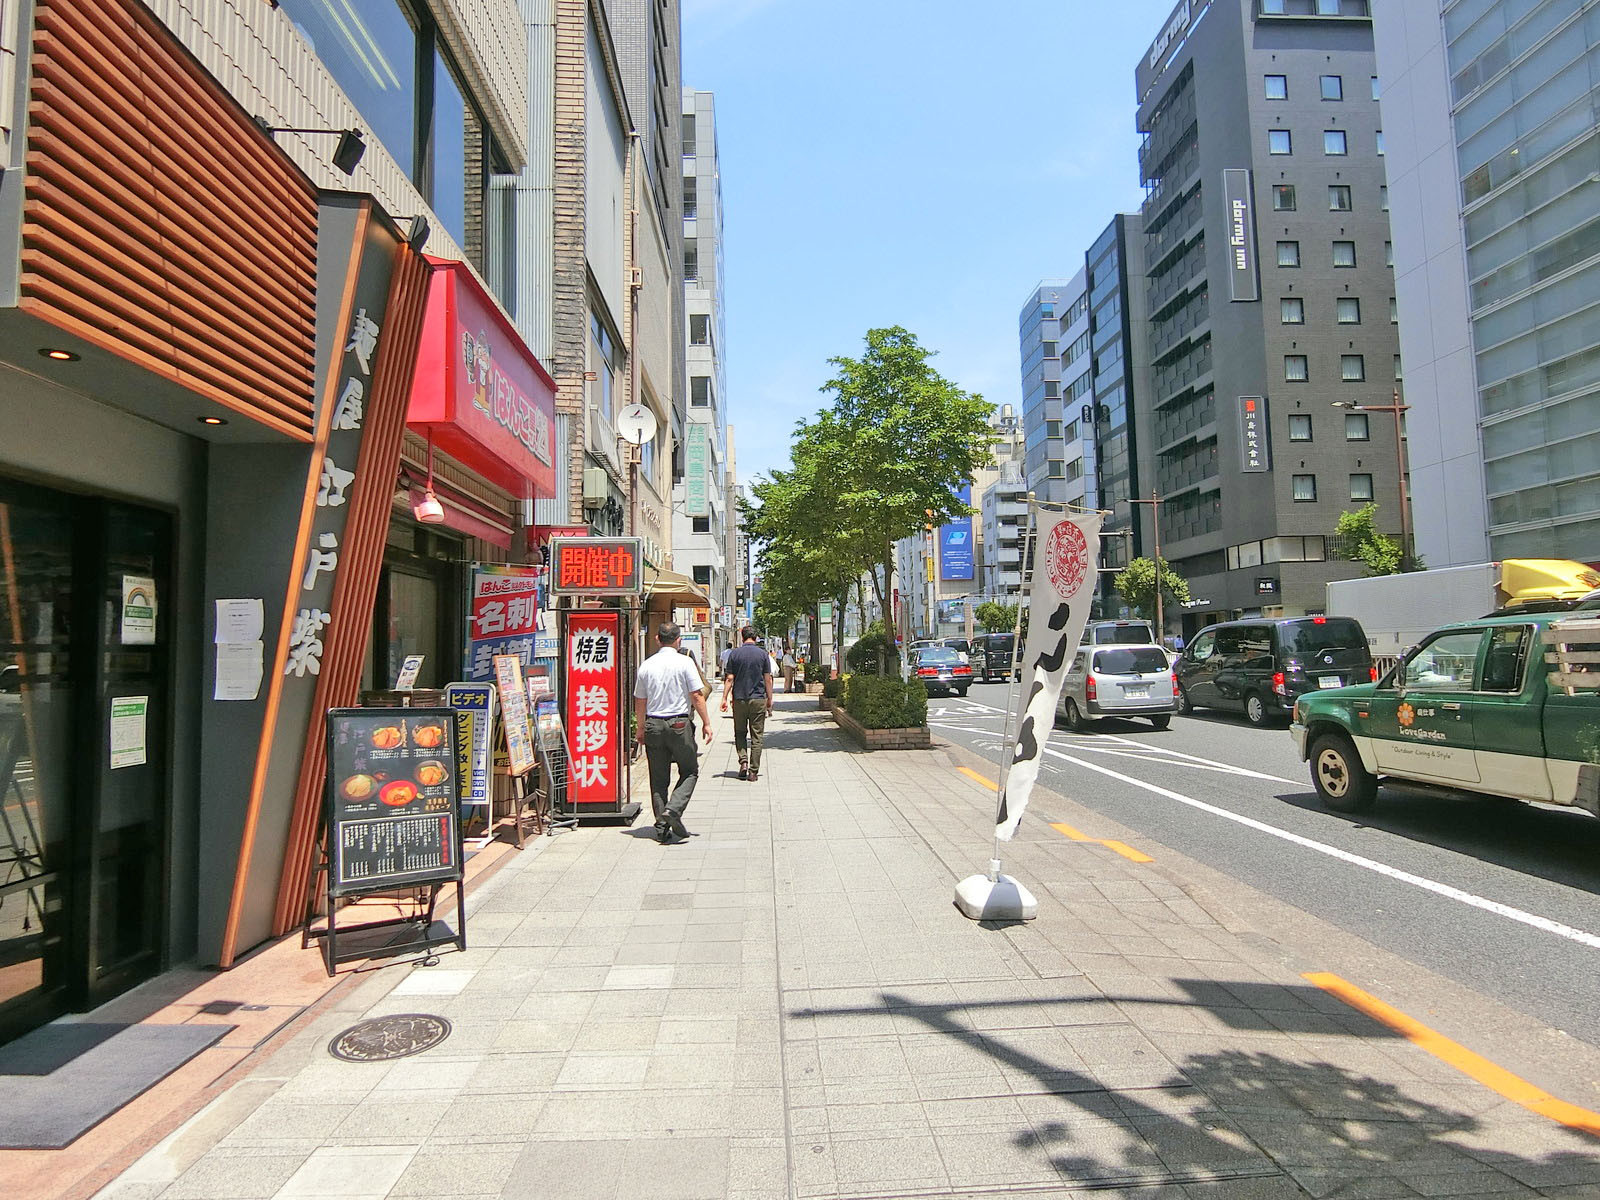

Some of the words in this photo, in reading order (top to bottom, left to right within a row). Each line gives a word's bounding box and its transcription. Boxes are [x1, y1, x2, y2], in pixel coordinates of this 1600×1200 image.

[1231, 199, 1247, 246] dormy
[1236, 249, 1247, 270] inn
[561, 546, 633, 587] 開催中
[480, 580, 512, 593] はんこ
[477, 594, 536, 635] 名刺
[576, 636, 610, 664] 特急
[452, 692, 487, 706] ビデオ
[575, 685, 609, 788] 挨拶状
